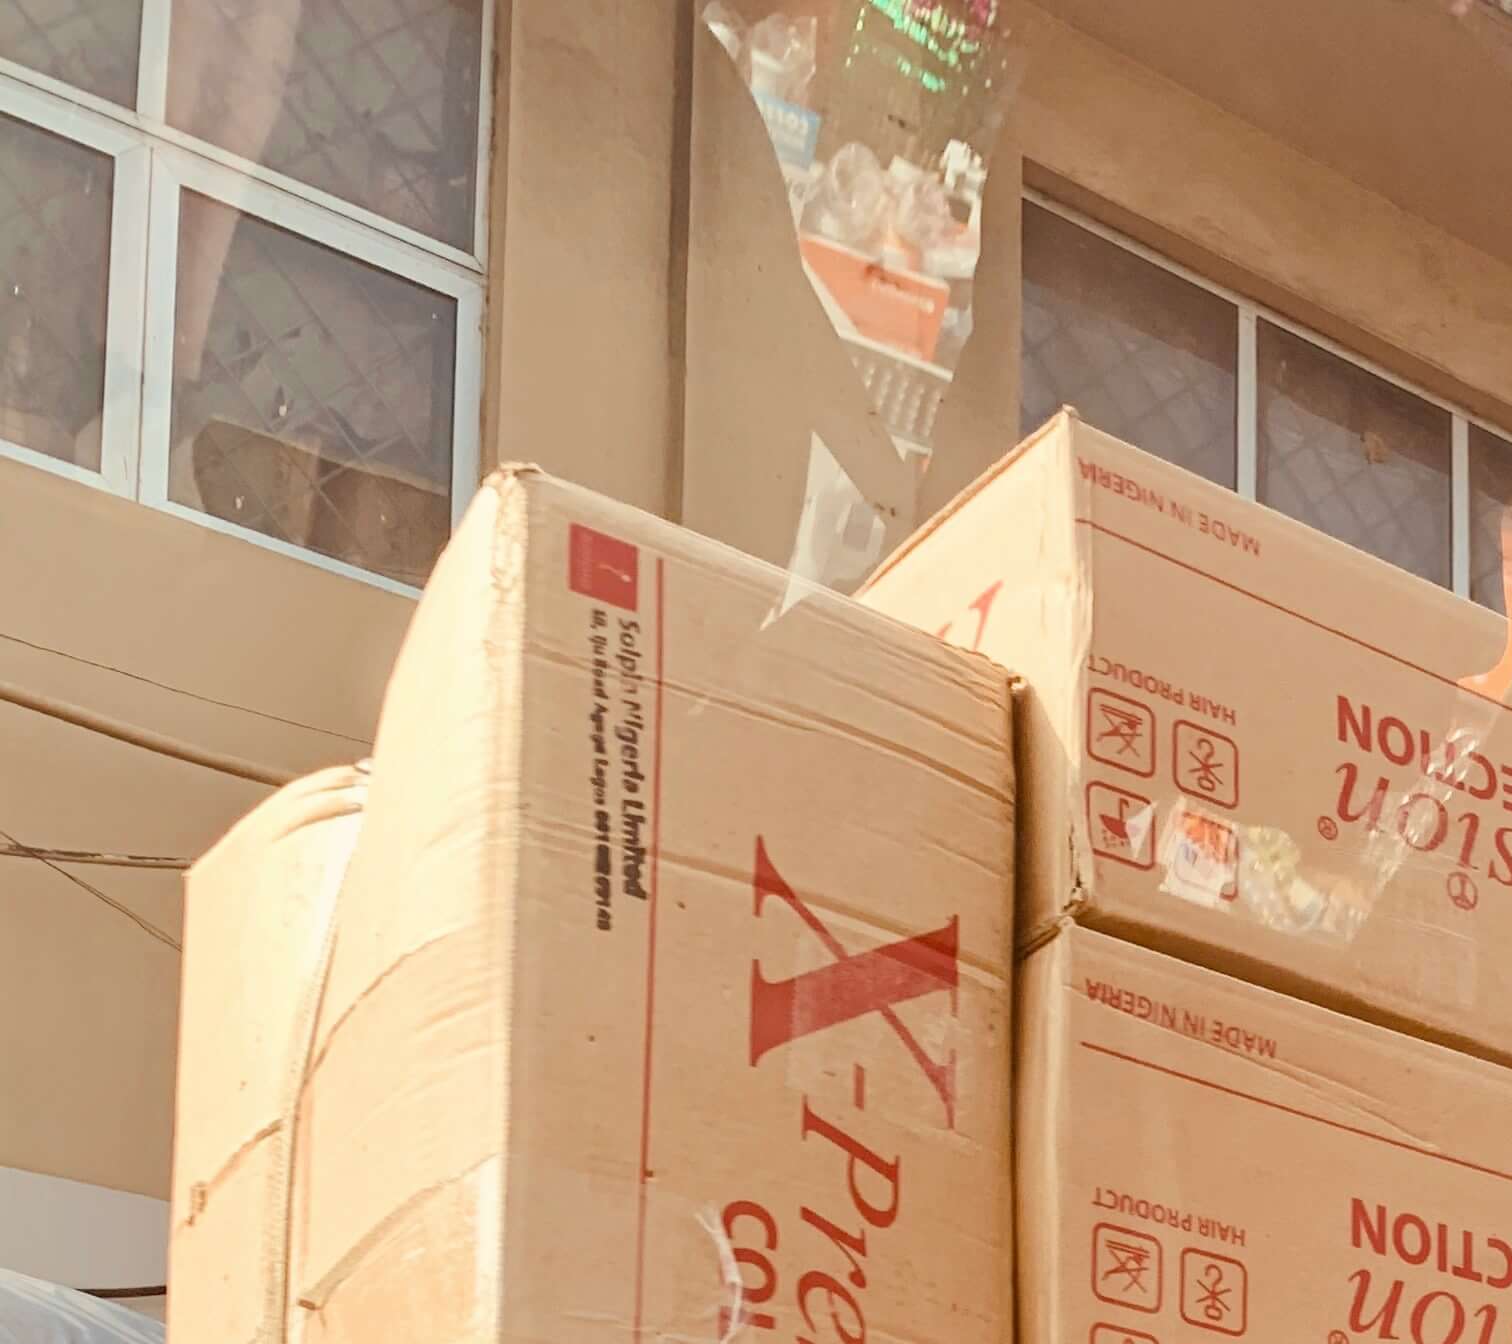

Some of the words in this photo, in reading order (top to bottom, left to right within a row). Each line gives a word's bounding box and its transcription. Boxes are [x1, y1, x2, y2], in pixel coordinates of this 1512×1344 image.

[1076, 457, 1166, 515] NIGERIA
[1170, 501, 1196, 526] IN
[1199, 512, 1261, 557] MADE
[1087, 653, 1186, 710] PRODUCT
[1189, 692, 1237, 727] HAIR
[1084, 977, 1178, 1034] NIGERIA
[1184, 1014, 1208, 1044] IN
[1212, 1023, 1277, 1060] MADE
[1091, 1185, 1194, 1234] PRODUCT
[1198, 1214, 1246, 1247] HAIR
